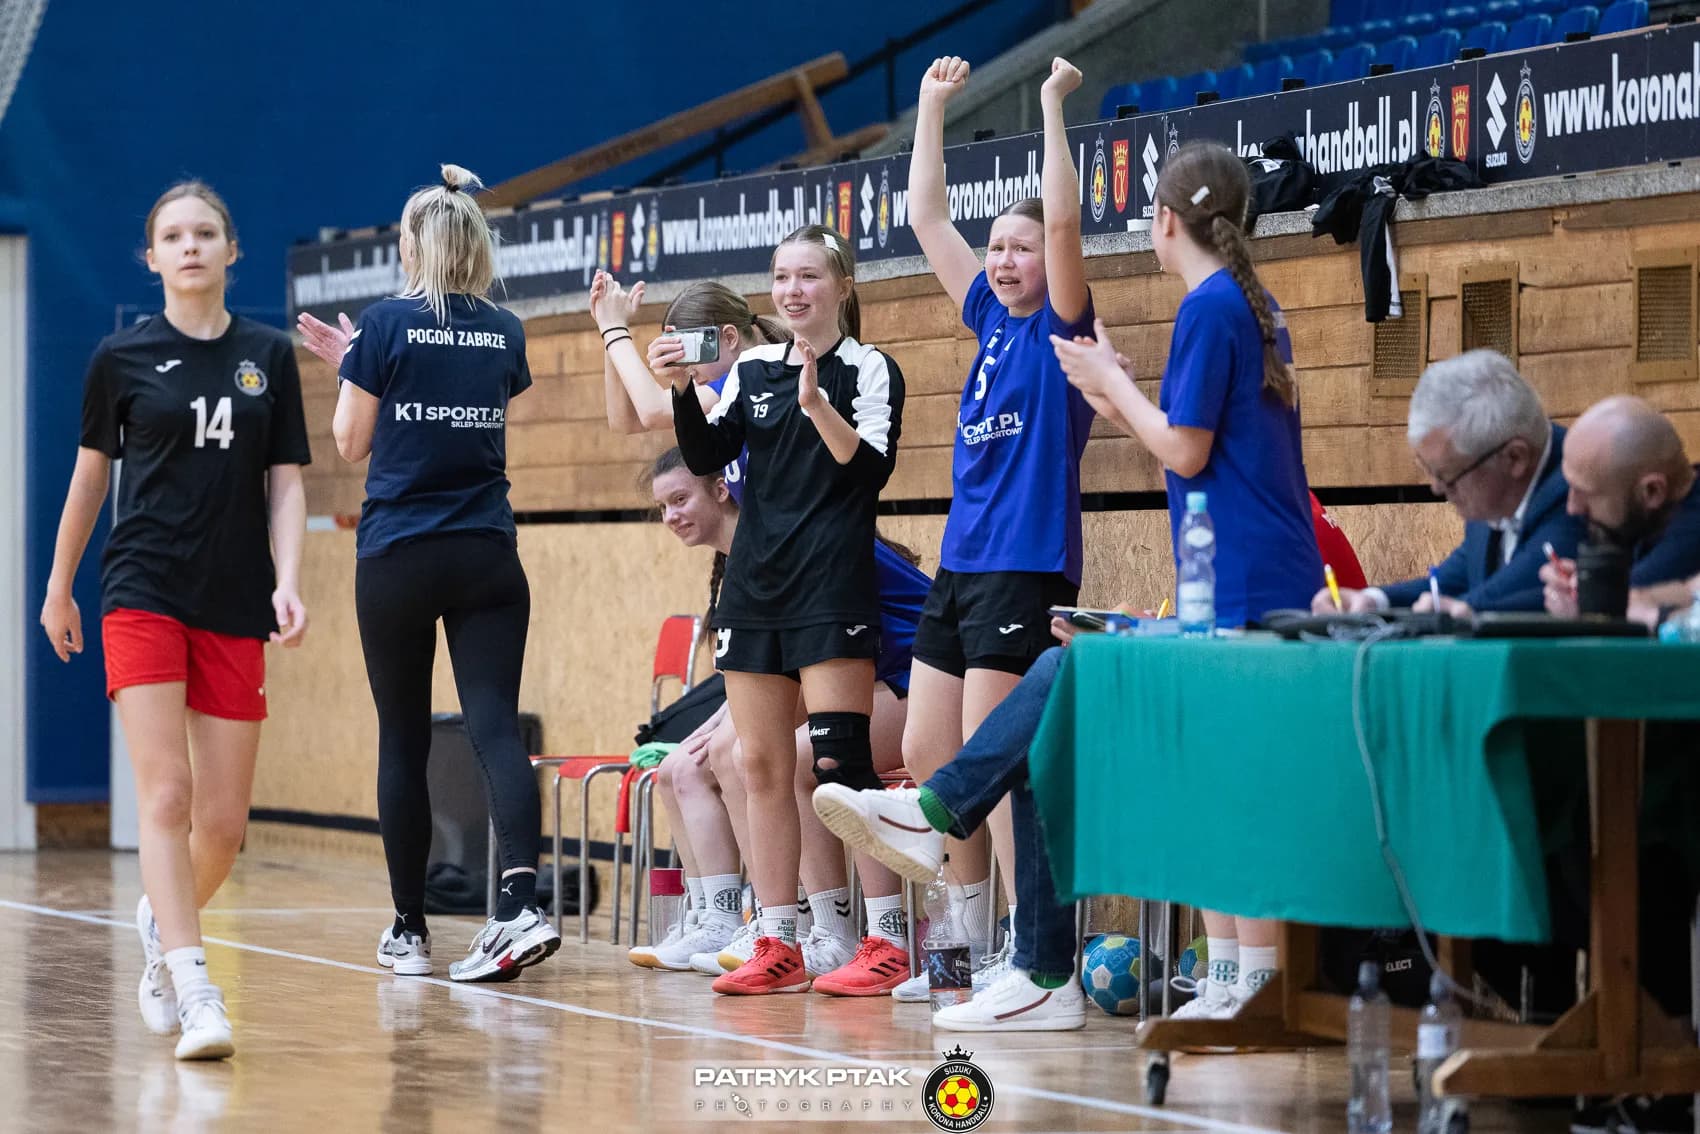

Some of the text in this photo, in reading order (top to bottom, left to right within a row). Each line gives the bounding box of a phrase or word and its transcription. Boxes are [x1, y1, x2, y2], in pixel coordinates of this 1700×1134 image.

[1485, 151, 1507, 168] SUZUKI
[1114, 169, 1126, 204] CK
[1142, 205, 1155, 217] SUZU
[407, 326, 507, 350] POGOŃ ZABRZE
[752, 403, 769, 418] 19
[189, 396, 235, 450] 14
[450, 421, 474, 429] SKLEP
